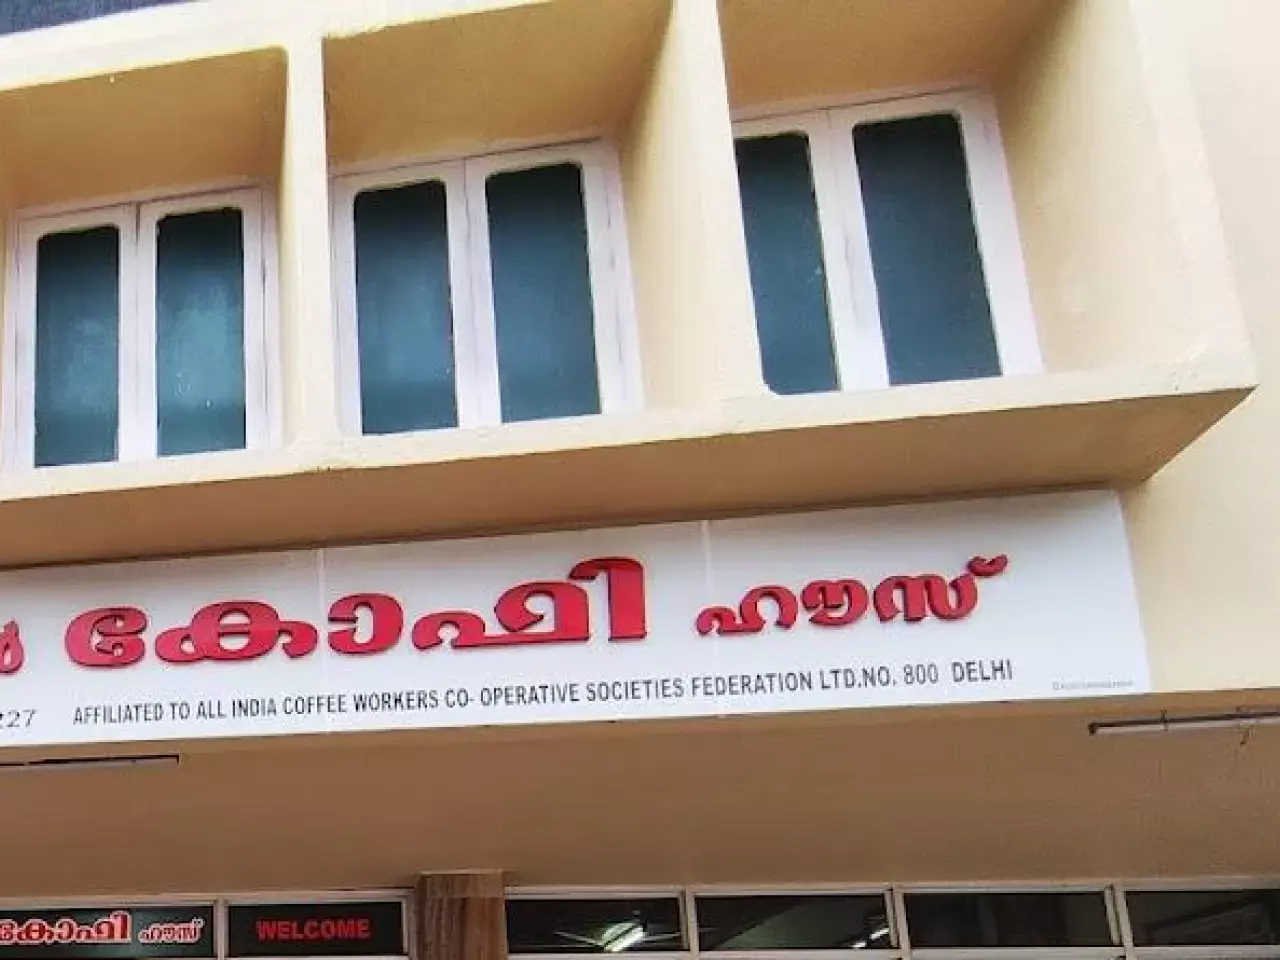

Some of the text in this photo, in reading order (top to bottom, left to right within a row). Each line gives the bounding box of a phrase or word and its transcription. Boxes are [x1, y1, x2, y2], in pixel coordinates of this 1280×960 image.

[64, 556, 648, 668] കോഫി
[73, 702, 164, 726] AFFILIATED
[170, 701, 191, 720] TO
[196, 699, 227, 720] ALL
[232, 697, 277, 719] INDIA
[283, 694, 348, 715] COFFEE
[354, 688, 439, 713] WORKERS
[480, 682, 580, 707] OPERATIVE
[586, 677, 685, 702] SOCIETIES
[691, 670, 813, 697] FEDERATION
[903, 663, 939, 685] 800
[951, 659, 1013, 683] DELHI
[255, 919, 371, 942] WELCOME
